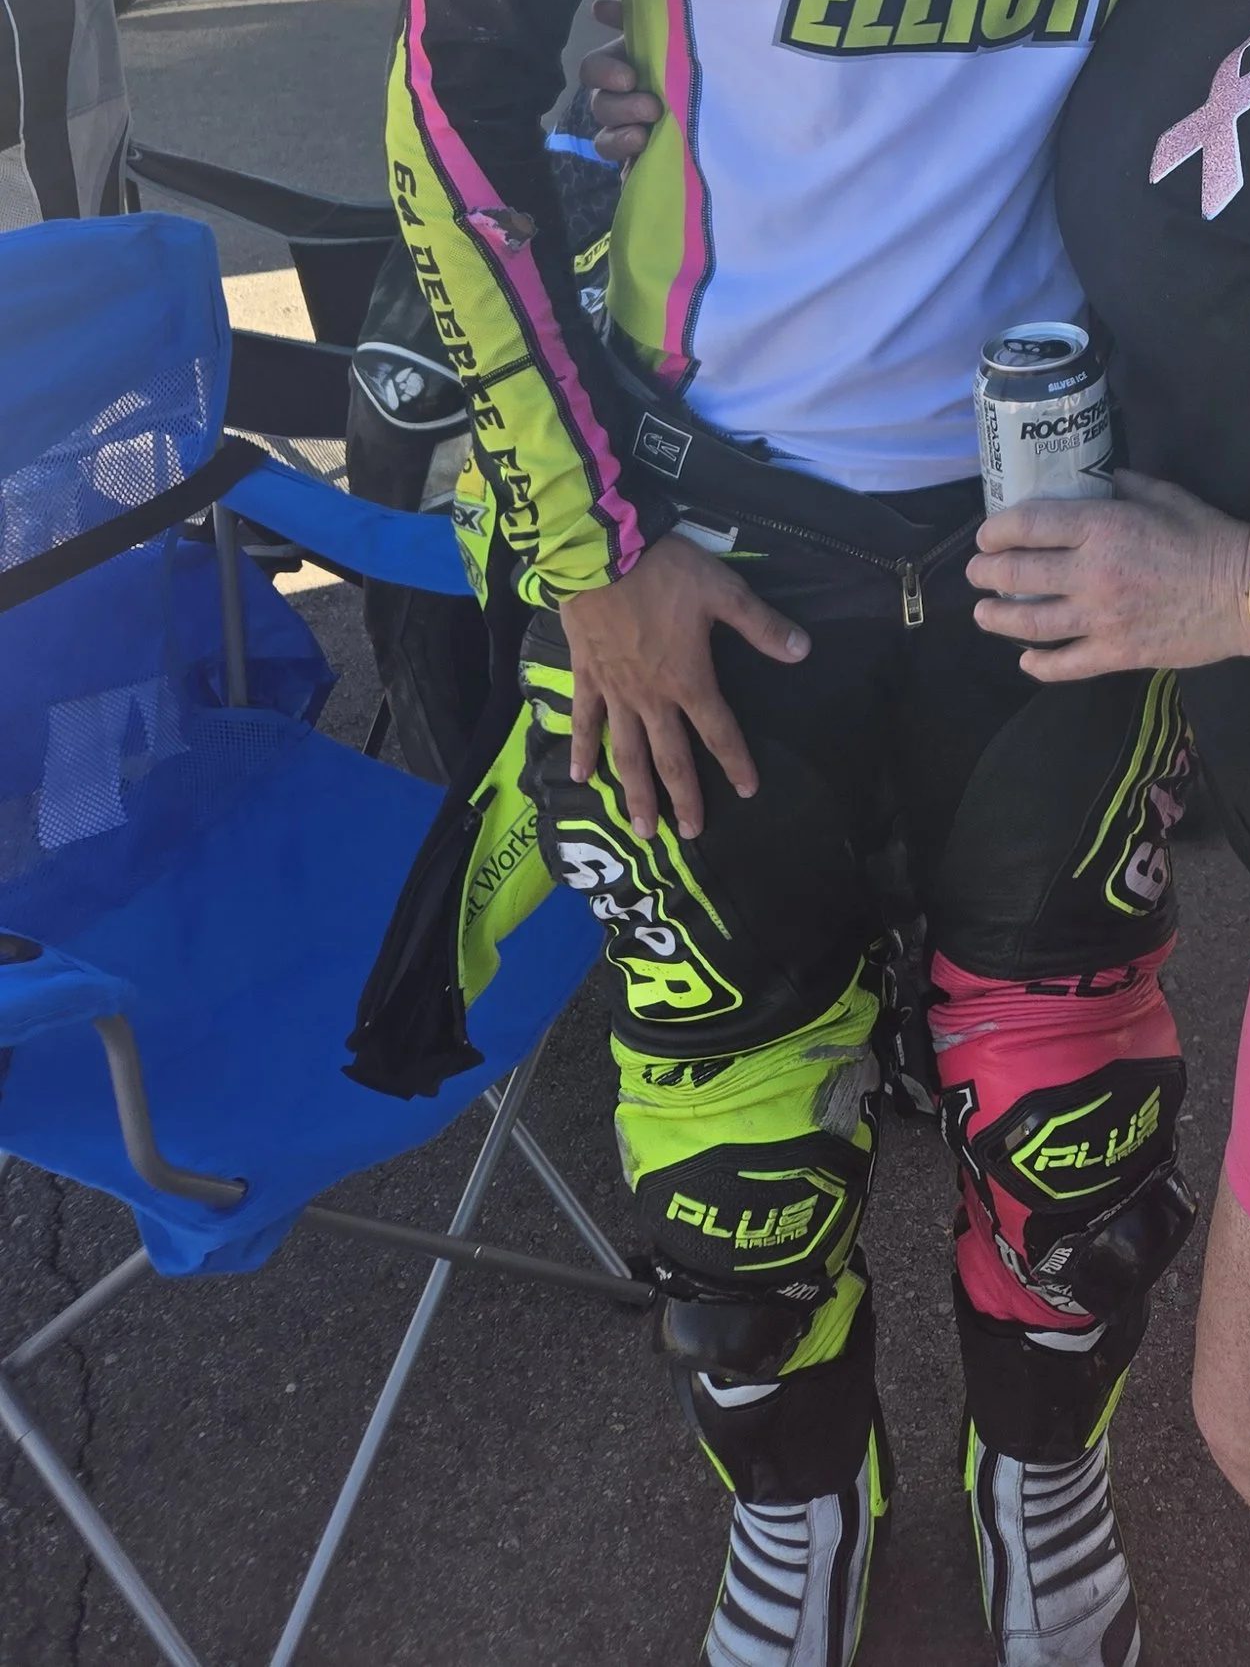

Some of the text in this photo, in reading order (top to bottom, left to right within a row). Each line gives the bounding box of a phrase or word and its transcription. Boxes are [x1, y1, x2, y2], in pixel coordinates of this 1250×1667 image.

[1048, 371, 1088, 392] SILVER ICE
[989, 402, 1003, 472] RECYCLE
[1035, 434, 1081, 455] PURE
[1033, 1085, 1161, 1172] PLUS
[665, 1191, 820, 1239] PLUS
[1039, 1247, 1073, 1275] FOUR
